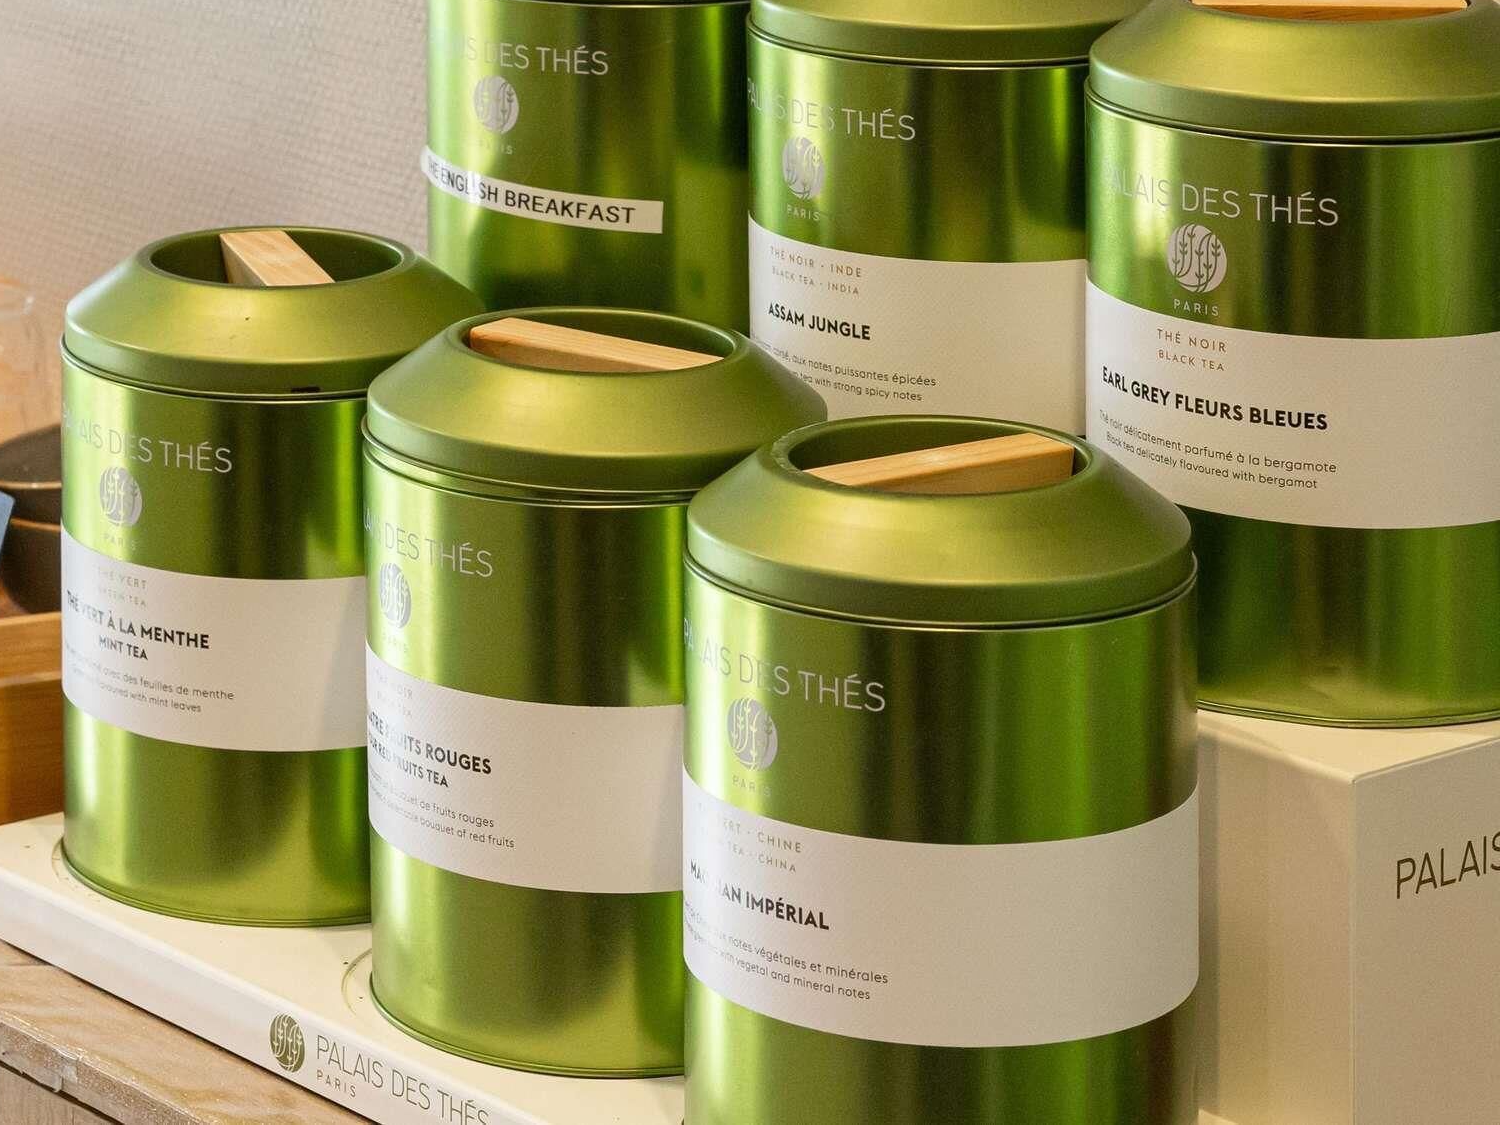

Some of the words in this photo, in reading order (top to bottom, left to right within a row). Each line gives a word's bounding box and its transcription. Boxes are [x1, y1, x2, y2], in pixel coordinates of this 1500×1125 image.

[485, 42, 529, 69] DES
[536, 45, 609, 76] THÉS
[792, 99, 835, 131] DES
[841, 108, 916, 141] THÉS
[504, 190, 636, 224] BREAKFAST
[787, 204, 820, 221] PARIS
[1182, 183, 1241, 219] DES
[1249, 191, 1339, 226] THÉS
[790, 254, 814, 268] NOIR
[830, 264, 862, 278] INDE
[799, 274, 814, 286] TEA
[828, 281, 859, 295] INDIA
[768, 302, 804, 328] ASSAM
[808, 315, 871, 340] JUNGLE
[1173, 298, 1220, 317] PARIS
[1157, 328, 1181, 344] THÉ
[1189, 337, 1226, 353] NOIR
[808, 358, 832, 373] notes
[835, 364, 889, 382] puissantes
[892, 372, 937, 388] épicées
[1158, 349, 1196, 367] BLACK
[1202, 359, 1224, 372] TEA
[833, 380, 863, 396] strong
[865, 384, 890, 399] spicy
[893, 389, 923, 401] notes
[1102, 366, 1128, 393] EARL
[1131, 381, 1171, 406] GREY
[1175, 393, 1244, 422] FLEURS
[1250, 406, 1328, 431] BLEUES
[159, 441, 233, 473] THÉS
[1107, 431, 1123, 448] Black
[1123, 442, 1135, 453] tea
[1137, 445, 1178, 468] delicately
[1179, 458, 1229, 478] flavoured
[1231, 469, 1255, 482] with
[1258, 474, 1318, 490] bergamot
[1123, 423, 1182, 452] délicatement
[1185, 442, 1233, 462] parfumé
[1236, 453, 1245, 463] à
[1249, 455, 1260, 466] la
[1264, 456, 1337, 474] bergamote
[385, 522, 420, 561] DES
[426, 542, 493, 577] THÉS
[107, 610, 115, 630] À
[119, 619, 137, 637] LA
[140, 625, 210, 649] MENTHE
[99, 634, 123, 652] MINT
[126, 643, 148, 660] TEA
[140, 676, 177, 693] feuilles
[176, 685, 189, 696] de
[192, 688, 235, 700] menthe
[740, 653, 790, 695] DES
[798, 673, 886, 713] THÉS
[149, 695, 169, 707] mint
[171, 699, 202, 712] leaves
[425, 743, 492, 774] ROUGES
[427, 768, 449, 788] TEA
[432, 802, 456, 819] fruits
[458, 811, 495, 828] rouges
[457, 828, 467, 838] of
[469, 832, 486, 843] red
[487, 834, 515, 848] fruits
[758, 831, 802, 853] CHINE
[758, 853, 796, 873] CHINA
[745, 890, 830, 930] IMPÉRIAL
[754, 943, 807, 970] végétales
[810, 961, 822, 974] et
[825, 963, 889, 984] minérales
[771, 970, 790, 984] and
[793, 977, 834, 994] mineral
[837, 985, 871, 1000] notes
[316, 1069, 357, 1098] PARIS
[317, 1034, 384, 1088] PALAIS
[392, 1069, 431, 1110] DES
[437, 1089, 489, 1125] THÉS
